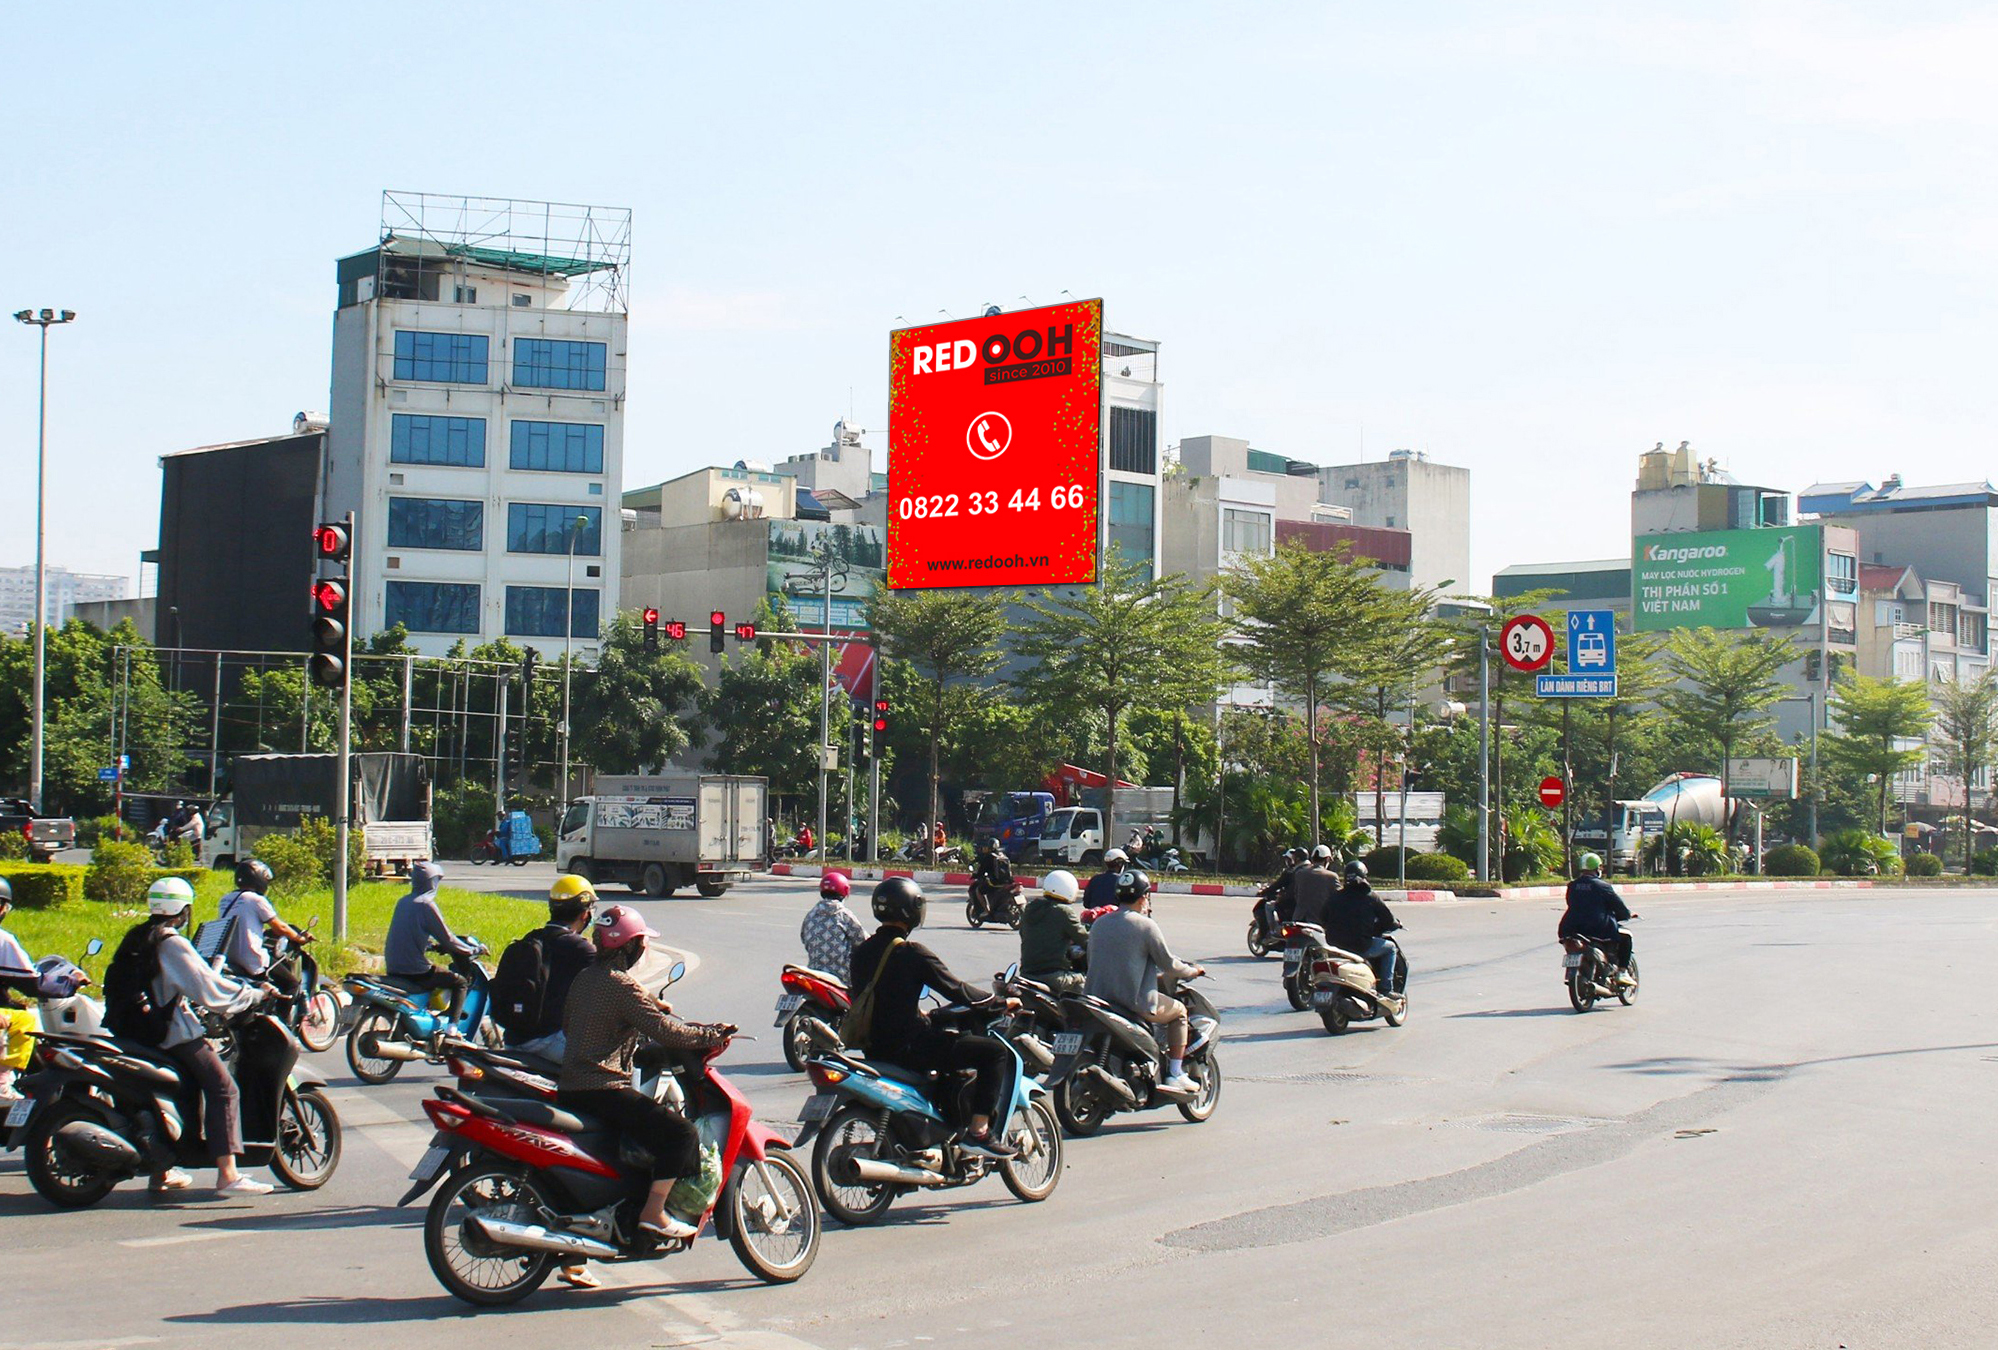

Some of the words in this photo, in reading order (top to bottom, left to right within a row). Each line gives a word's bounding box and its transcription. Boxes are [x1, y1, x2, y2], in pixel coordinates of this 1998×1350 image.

[913, 339, 977, 375] RED
[982, 323, 1073, 365] OOH
[989, 367, 1028, 382] since
[1032, 361, 1066, 376] 2010
[899, 493, 959, 520] 0822
[968, 491, 999, 515] 33
[1008, 487, 1041, 512] 44
[1050, 484, 1084, 509] 66
[1643, 544, 1727, 563] Kangaroo
[927, 554, 1049, 572] www.redooh.vn
[1701, 567, 1746, 577] HYDROGEN
[1721, 583, 1728, 595] 1
[1672, 600, 1700, 612] NAM
[666, 623, 684, 638] 46
[737, 626, 753, 638] 47
[1513, 632, 1530, 654] 3,7
[1533, 644, 1541, 653] m
[1599, 680, 1613, 692] BRT
